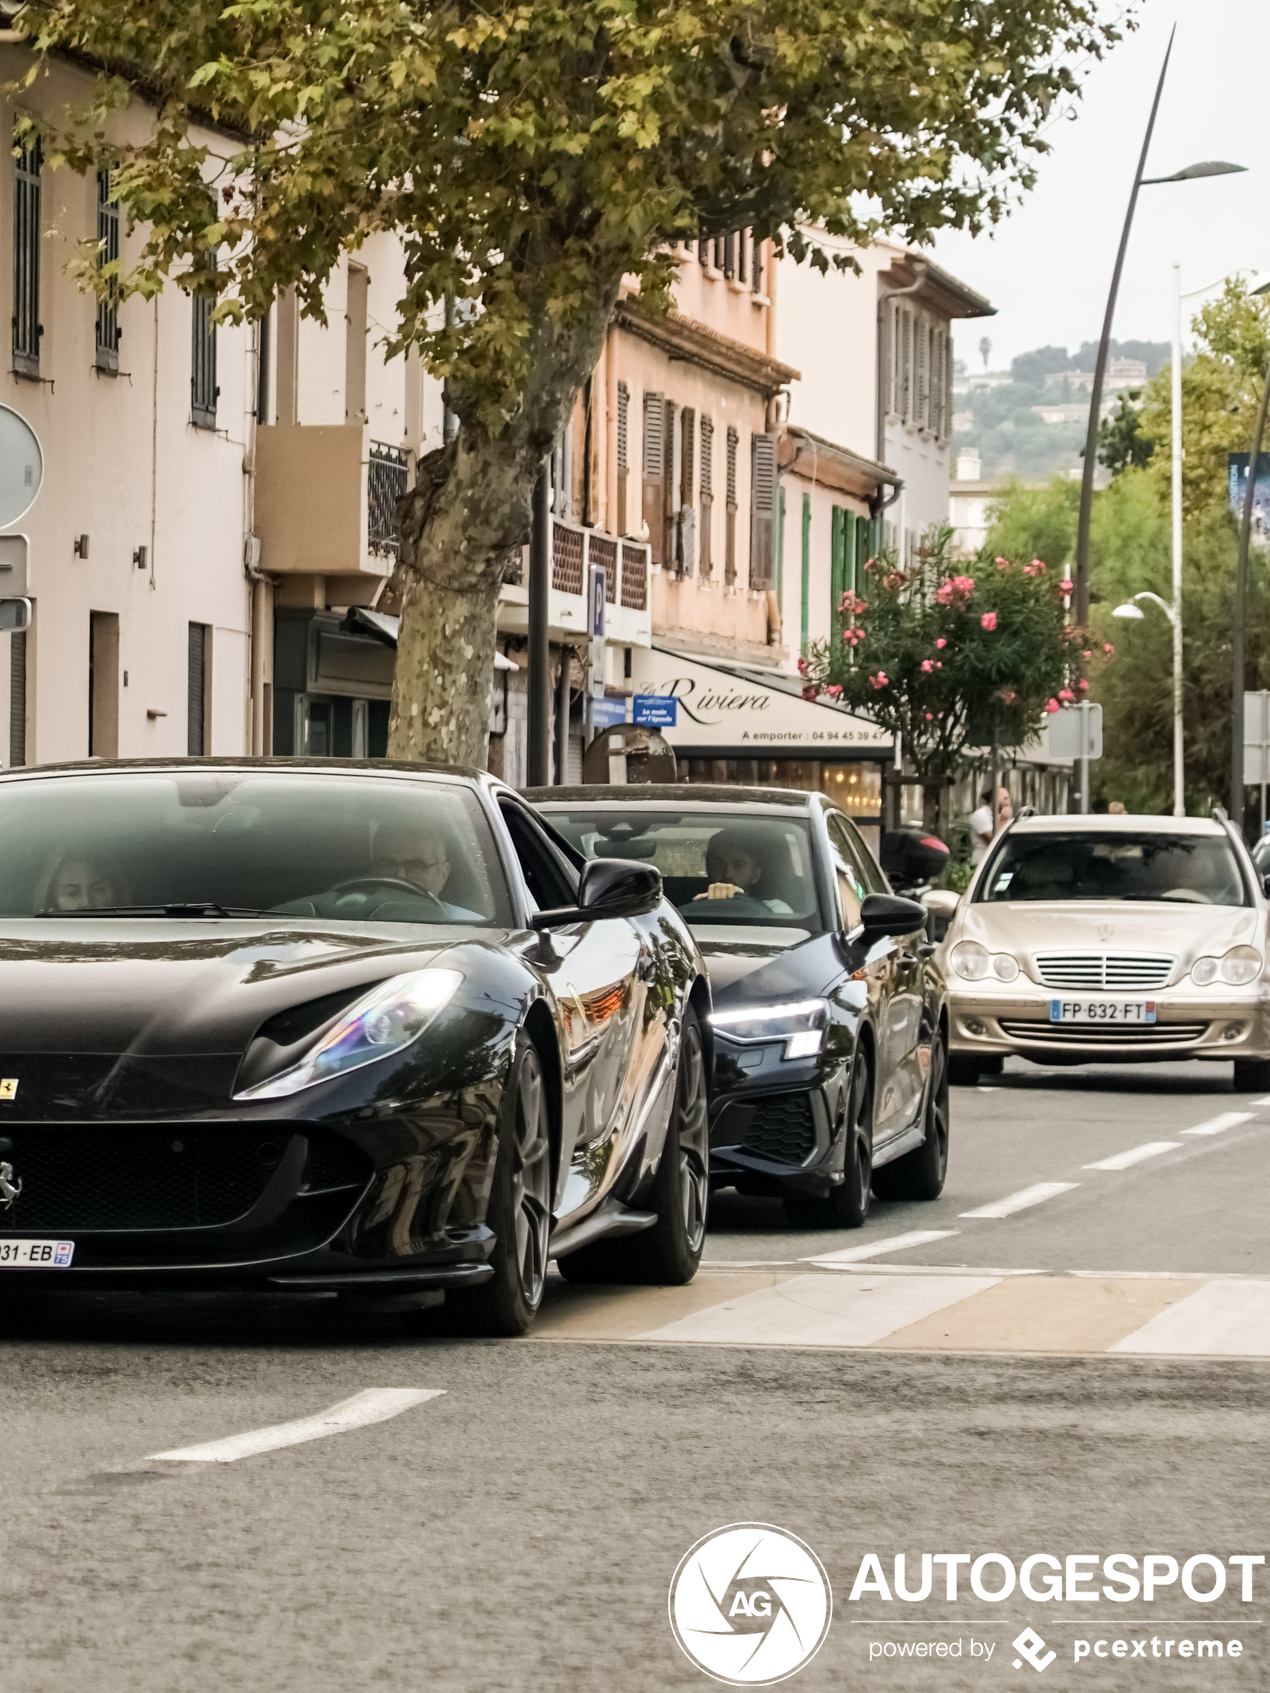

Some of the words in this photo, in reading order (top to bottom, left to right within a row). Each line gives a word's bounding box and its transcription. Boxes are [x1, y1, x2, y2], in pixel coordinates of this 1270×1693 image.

[596, 582, 603, 625] P
[661, 677, 772, 725] Riviera
[753, 731, 803, 742] emporter
[812, 731, 824, 740] 04
[827, 731, 839, 740] 94
[842, 731, 854, 740] 45
[857, 731, 869, 740] 39
[872, 731, 885, 740] 47
[1062, 1002, 1144, 1019] FP-632-FT
[55, 1255, 68, 1264] 75
